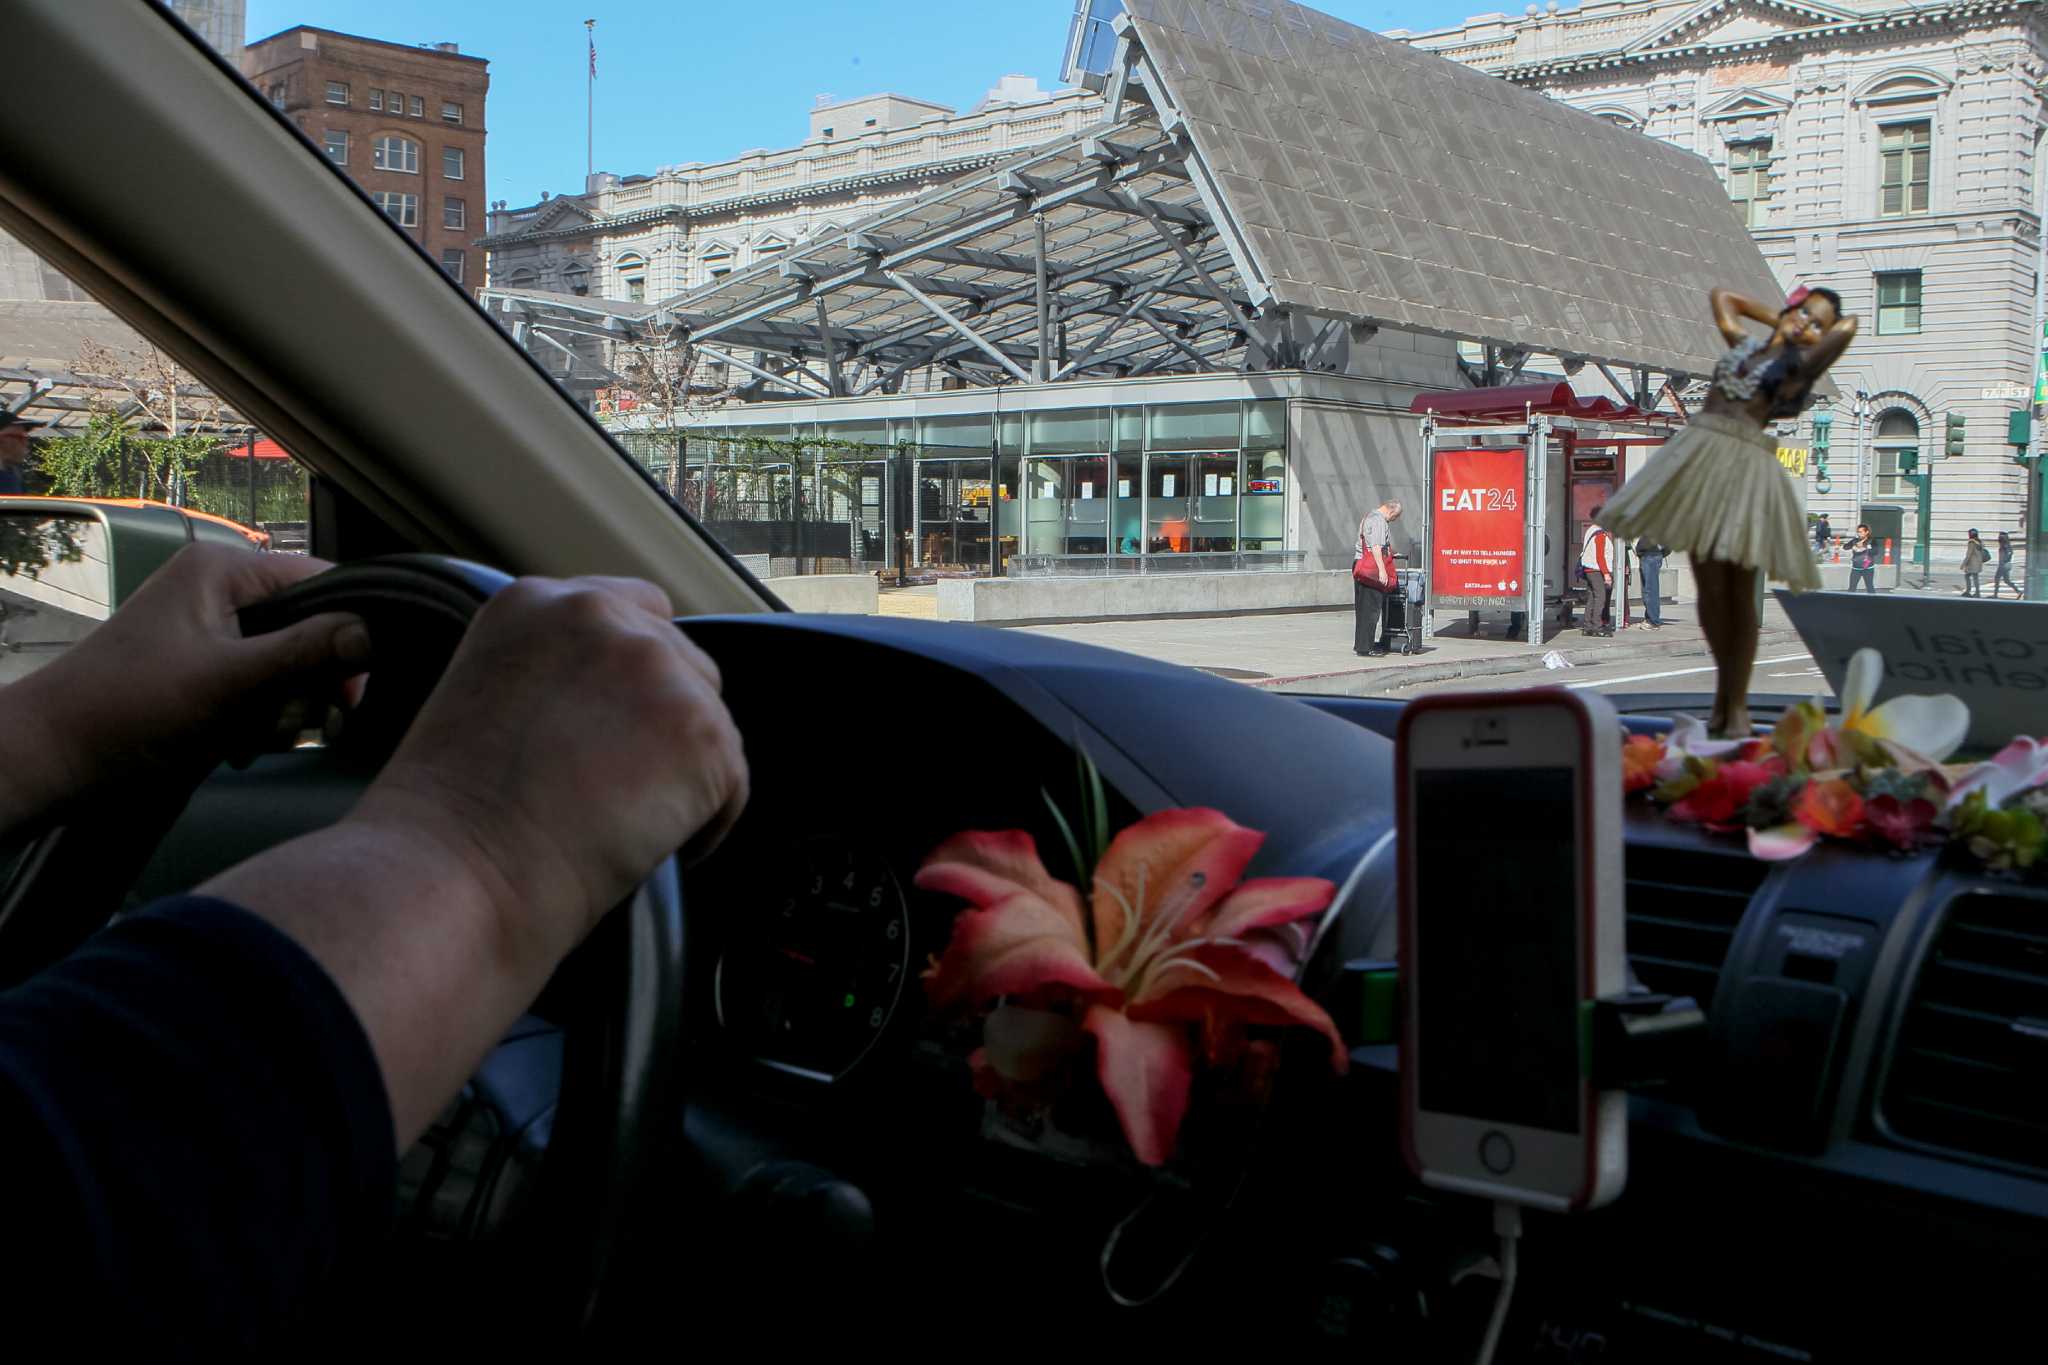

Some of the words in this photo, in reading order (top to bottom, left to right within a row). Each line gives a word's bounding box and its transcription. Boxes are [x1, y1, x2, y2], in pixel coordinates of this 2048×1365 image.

[1441, 487, 1518, 511] EAT24
[886, 917, 900, 940] 6
[888, 961, 901, 984] 7
[870, 1006, 883, 1027] 8
